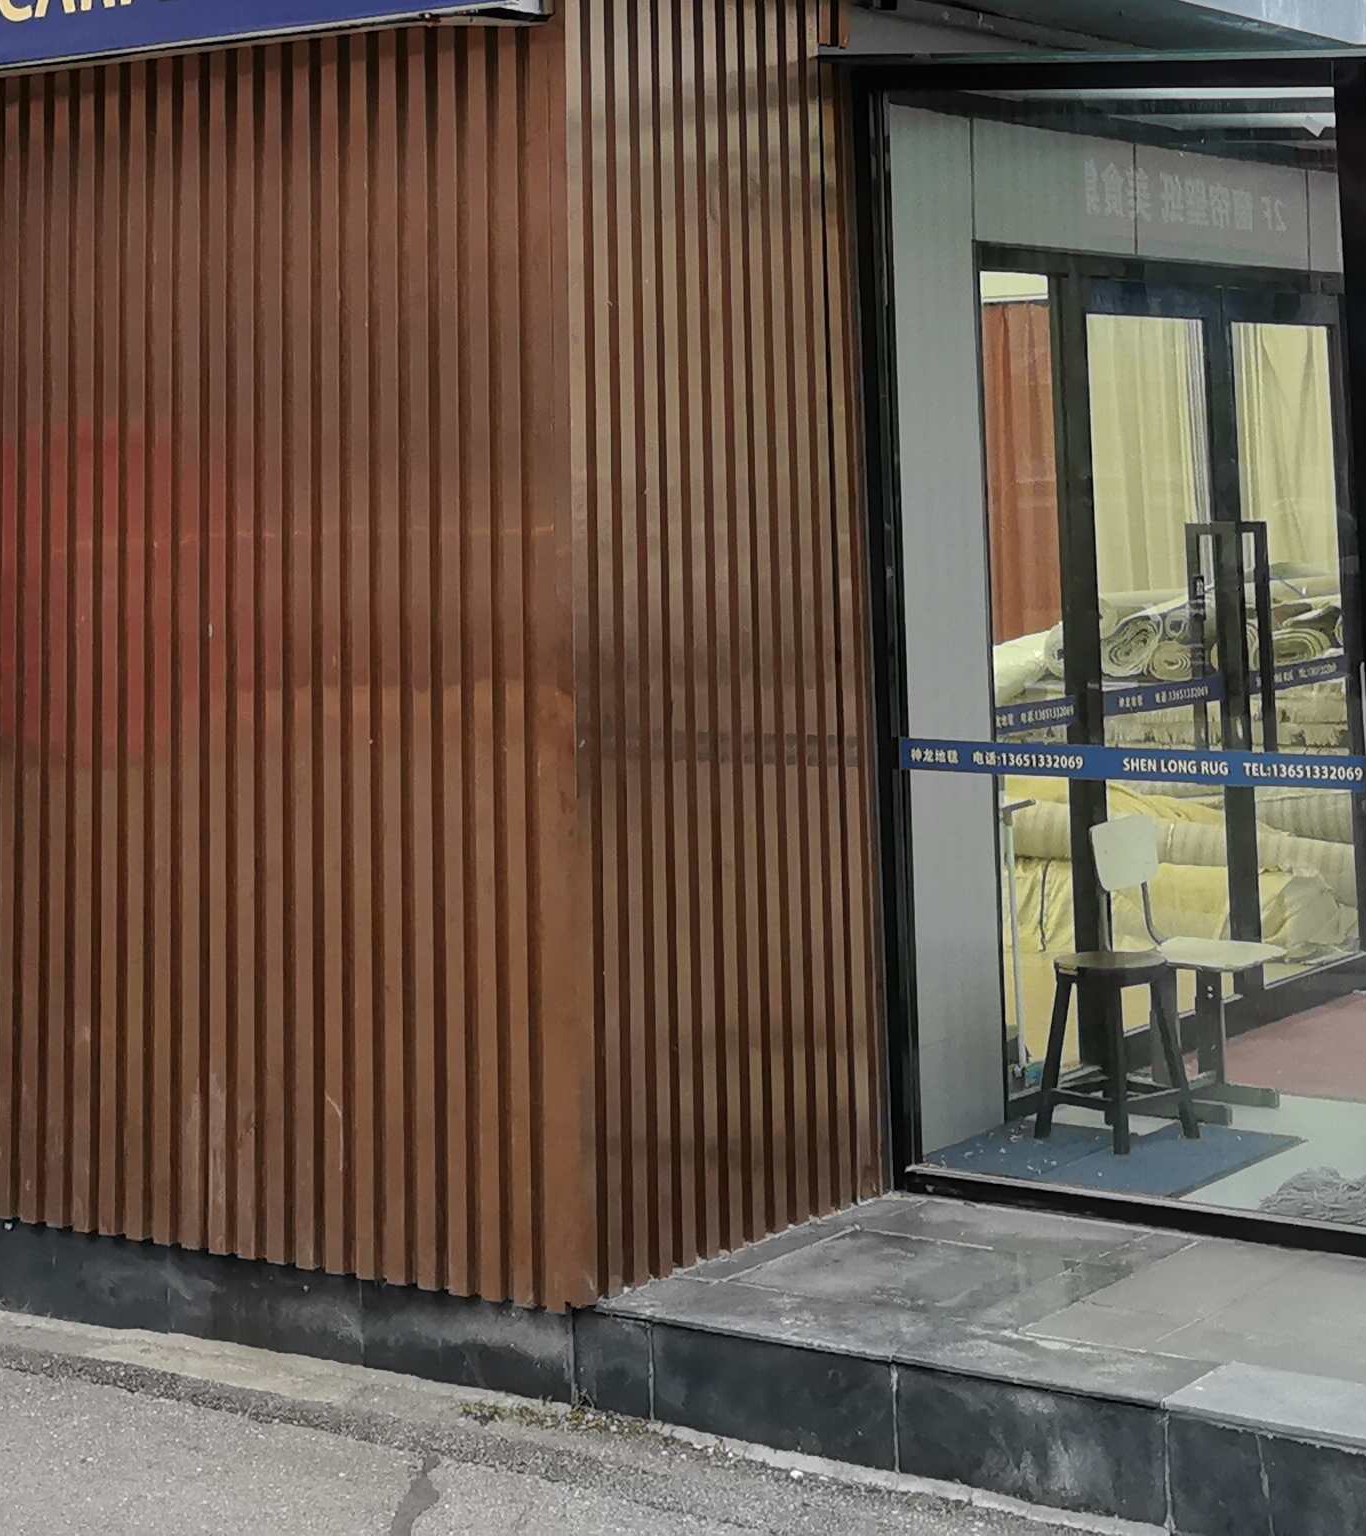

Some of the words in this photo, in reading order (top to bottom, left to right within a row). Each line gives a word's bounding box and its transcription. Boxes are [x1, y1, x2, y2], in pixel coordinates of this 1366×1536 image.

[910, 747, 960, 764] 神龙地毯
[1122, 757, 1157, 773] SHEN
[1160, 759, 1197, 774] LONG
[1201, 761, 1229, 776] RUG
[1243, 762, 1364, 781] TEL:13651332069
